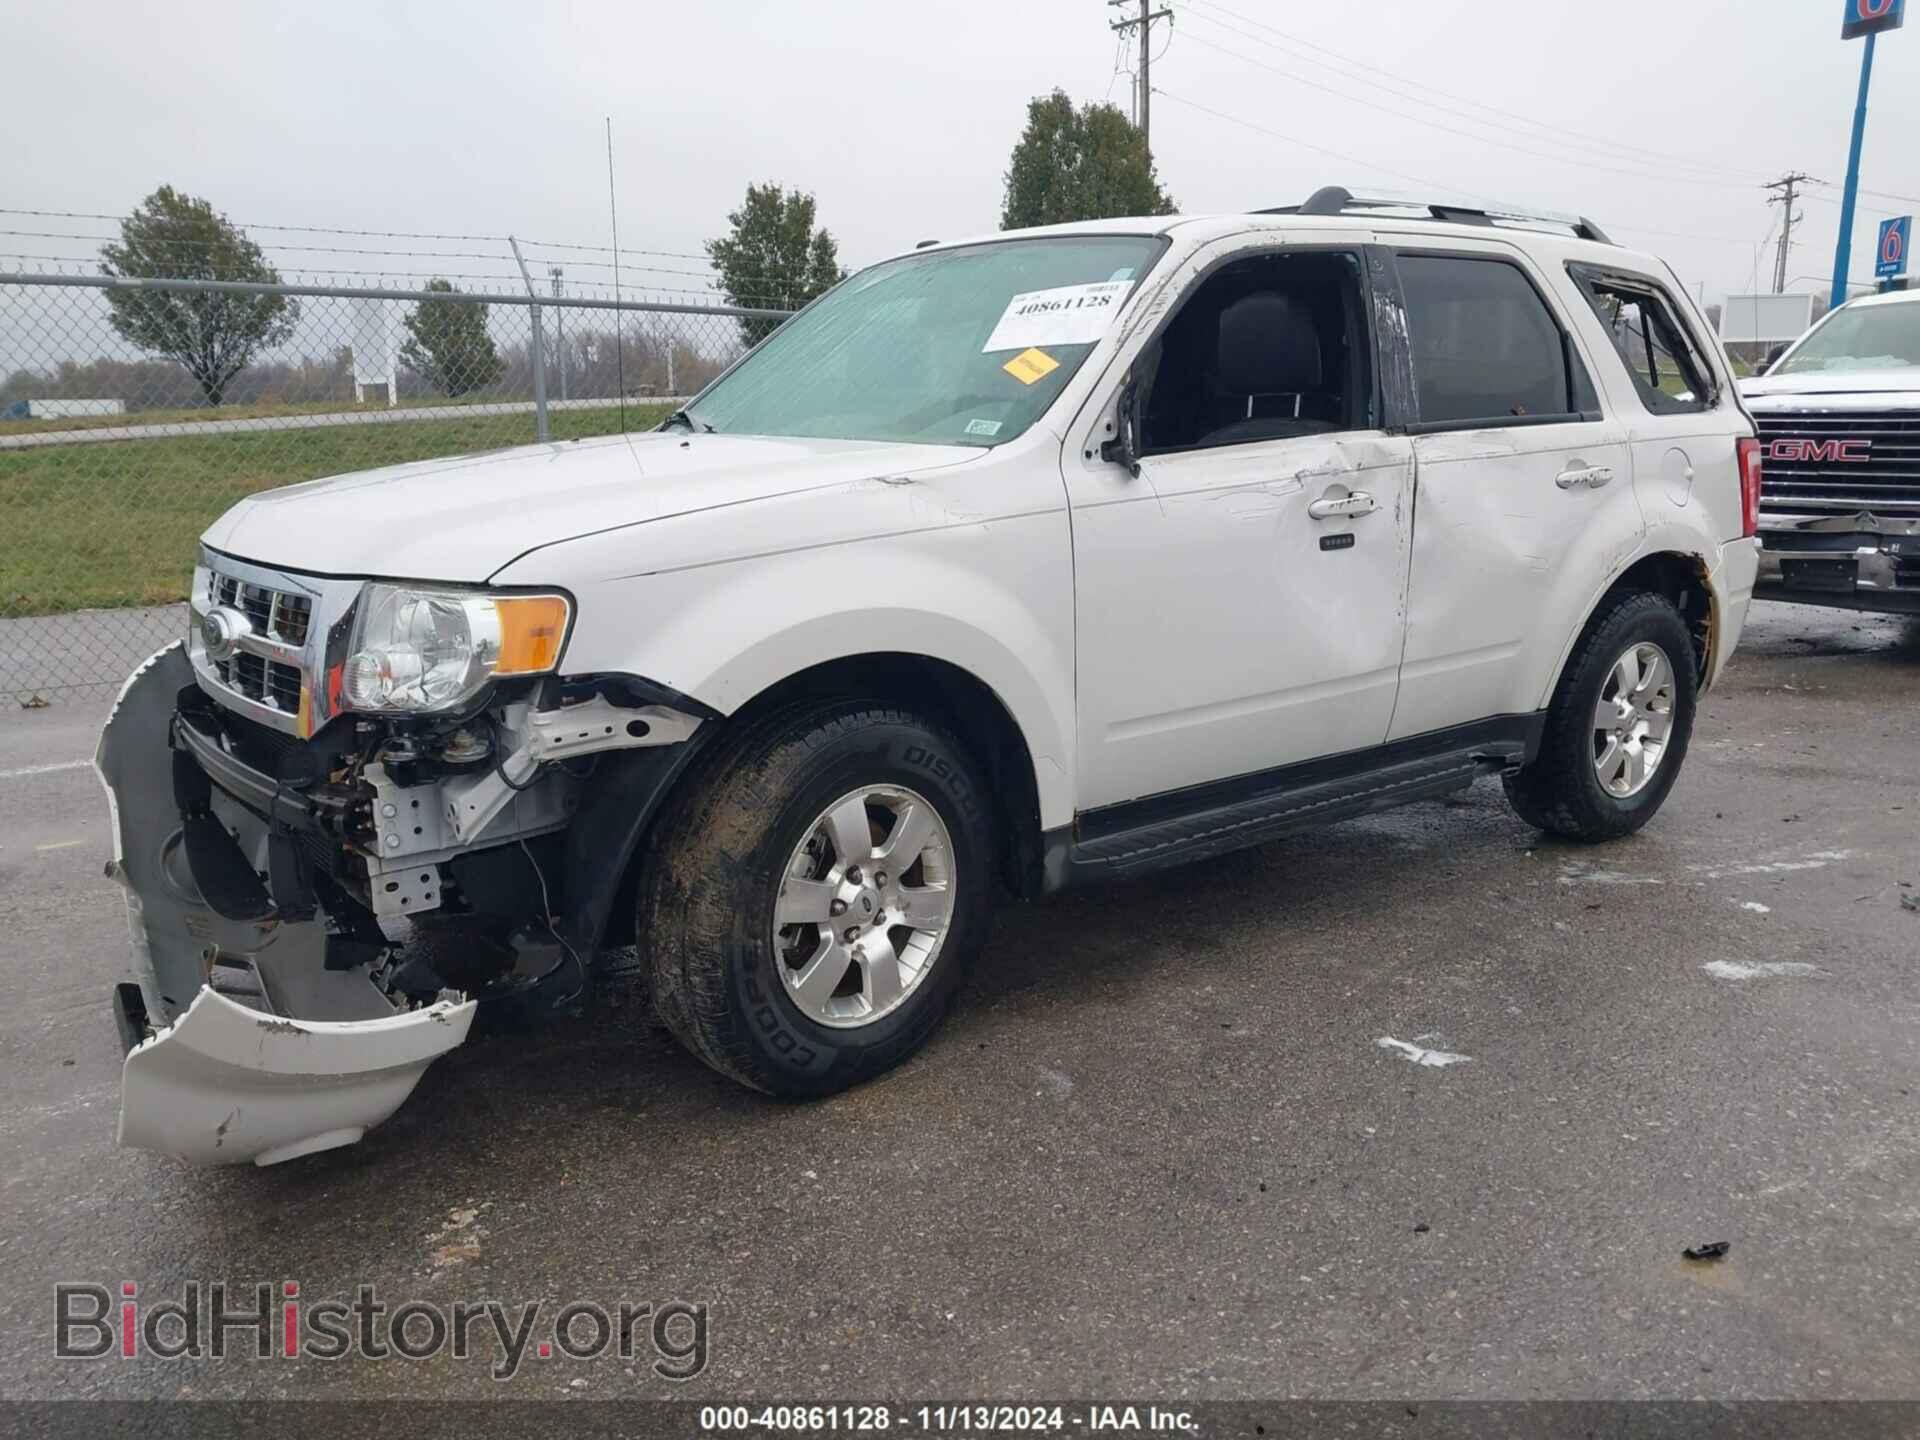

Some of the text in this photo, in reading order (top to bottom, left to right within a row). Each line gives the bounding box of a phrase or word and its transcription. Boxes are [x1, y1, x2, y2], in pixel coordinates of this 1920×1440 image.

[1882, 219, 1902, 263] 6
[1015, 294, 1112, 316] 40861128
[1770, 438, 1872, 462] GMC
